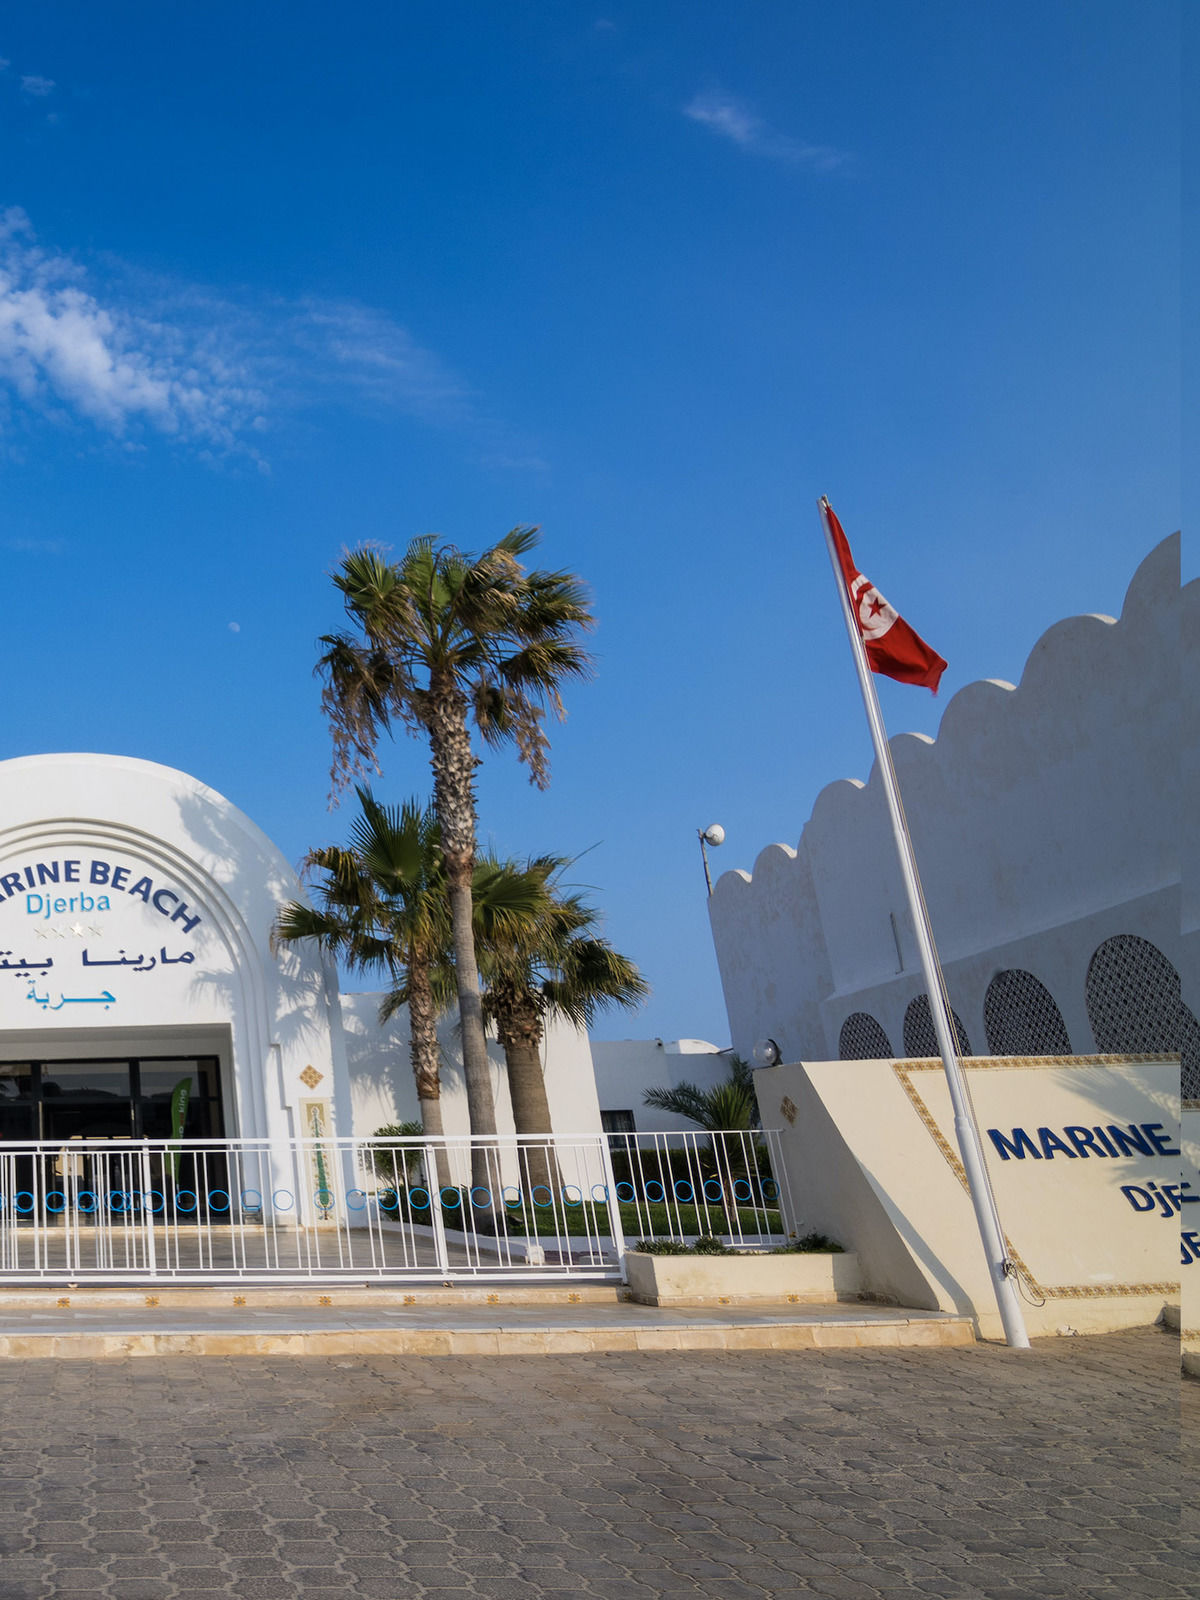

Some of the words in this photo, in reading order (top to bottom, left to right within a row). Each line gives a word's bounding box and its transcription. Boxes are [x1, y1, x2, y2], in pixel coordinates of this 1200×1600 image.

[26, 891, 111, 919] Djerba
[89, 860, 201, 934] BEACH
[82, 946, 196, 971] مارينا
[26, 980, 117, 1010] جربة
[987, 1123, 1181, 1160] MARINE
